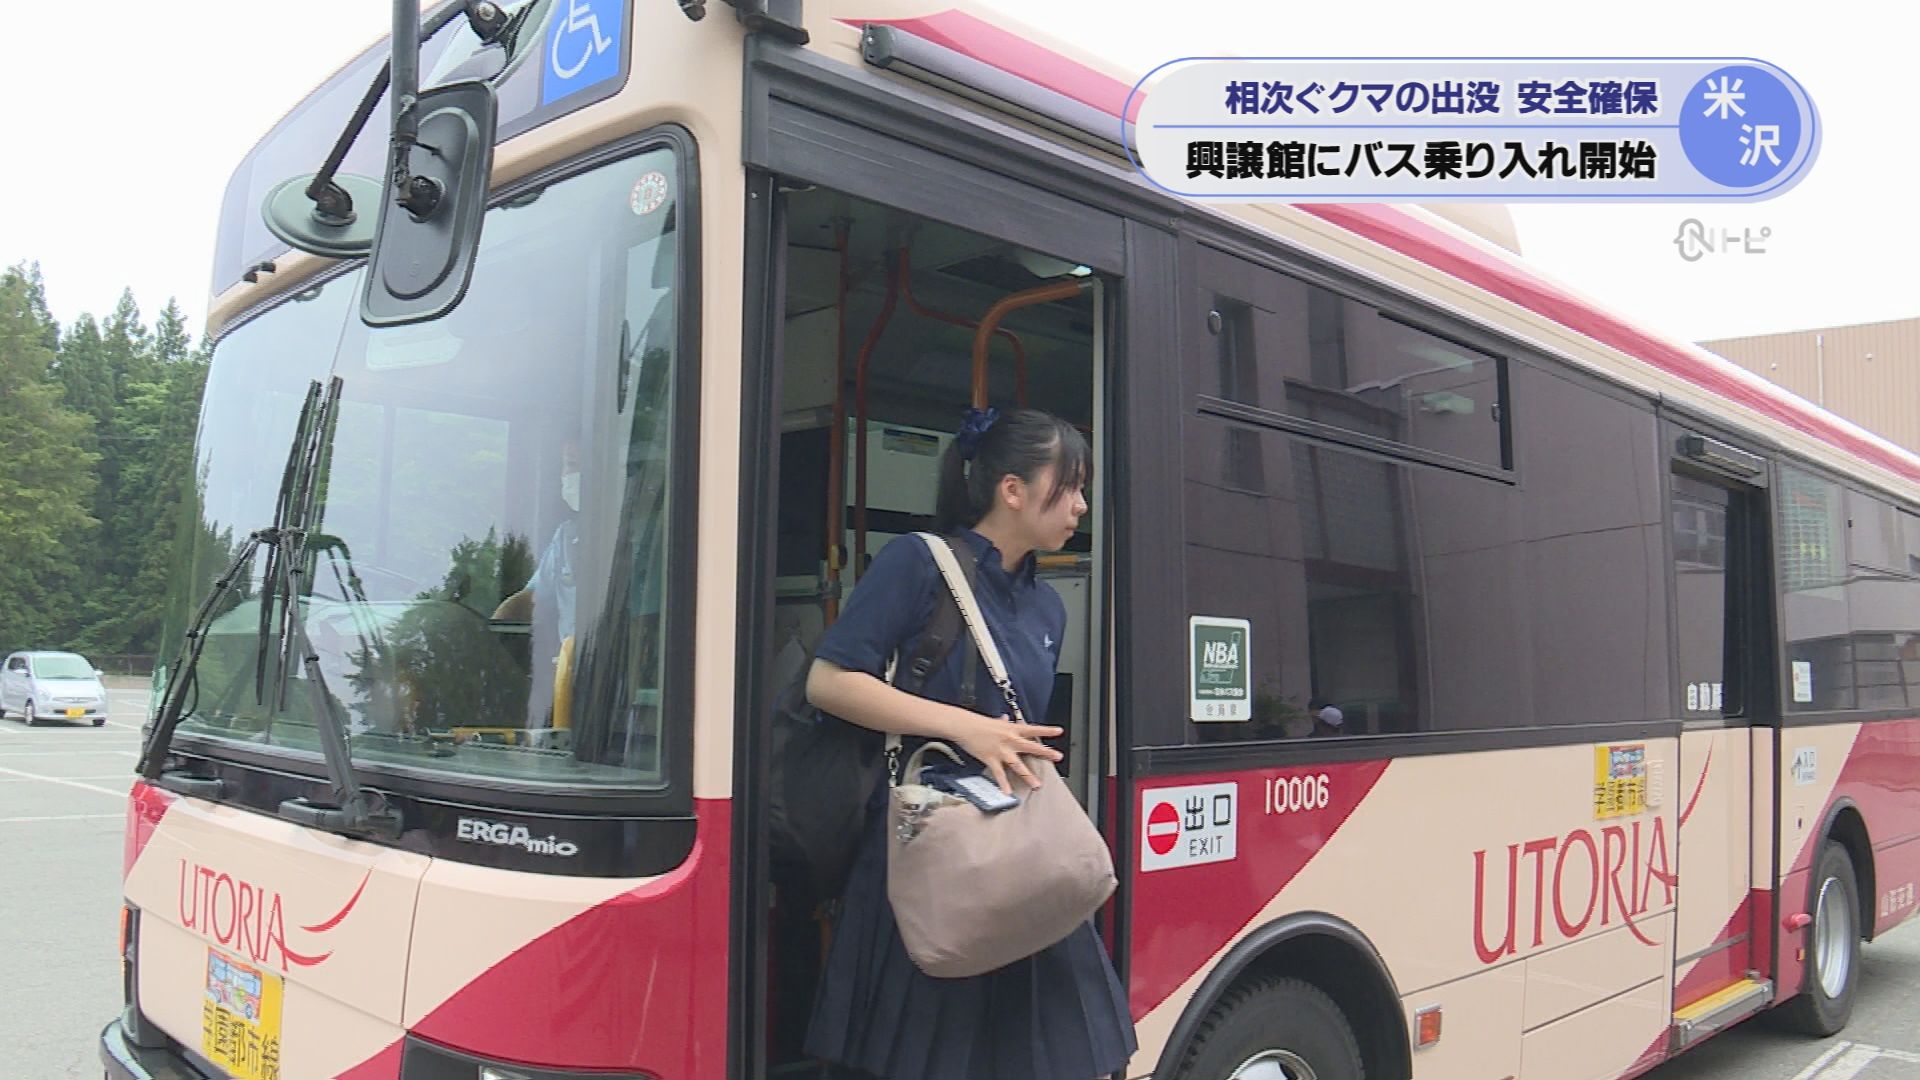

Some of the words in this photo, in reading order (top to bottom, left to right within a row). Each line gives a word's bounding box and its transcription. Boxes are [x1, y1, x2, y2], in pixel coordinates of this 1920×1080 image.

[1203, 641, 1239, 664] NBA
[1184, 794, 1231, 832] 出口
[1265, 774, 1329, 815] 10006
[1189, 835, 1224, 857] EXIT
[1473, 815, 1679, 965] UTORIA
[179, 858, 312, 972] UTORIA
